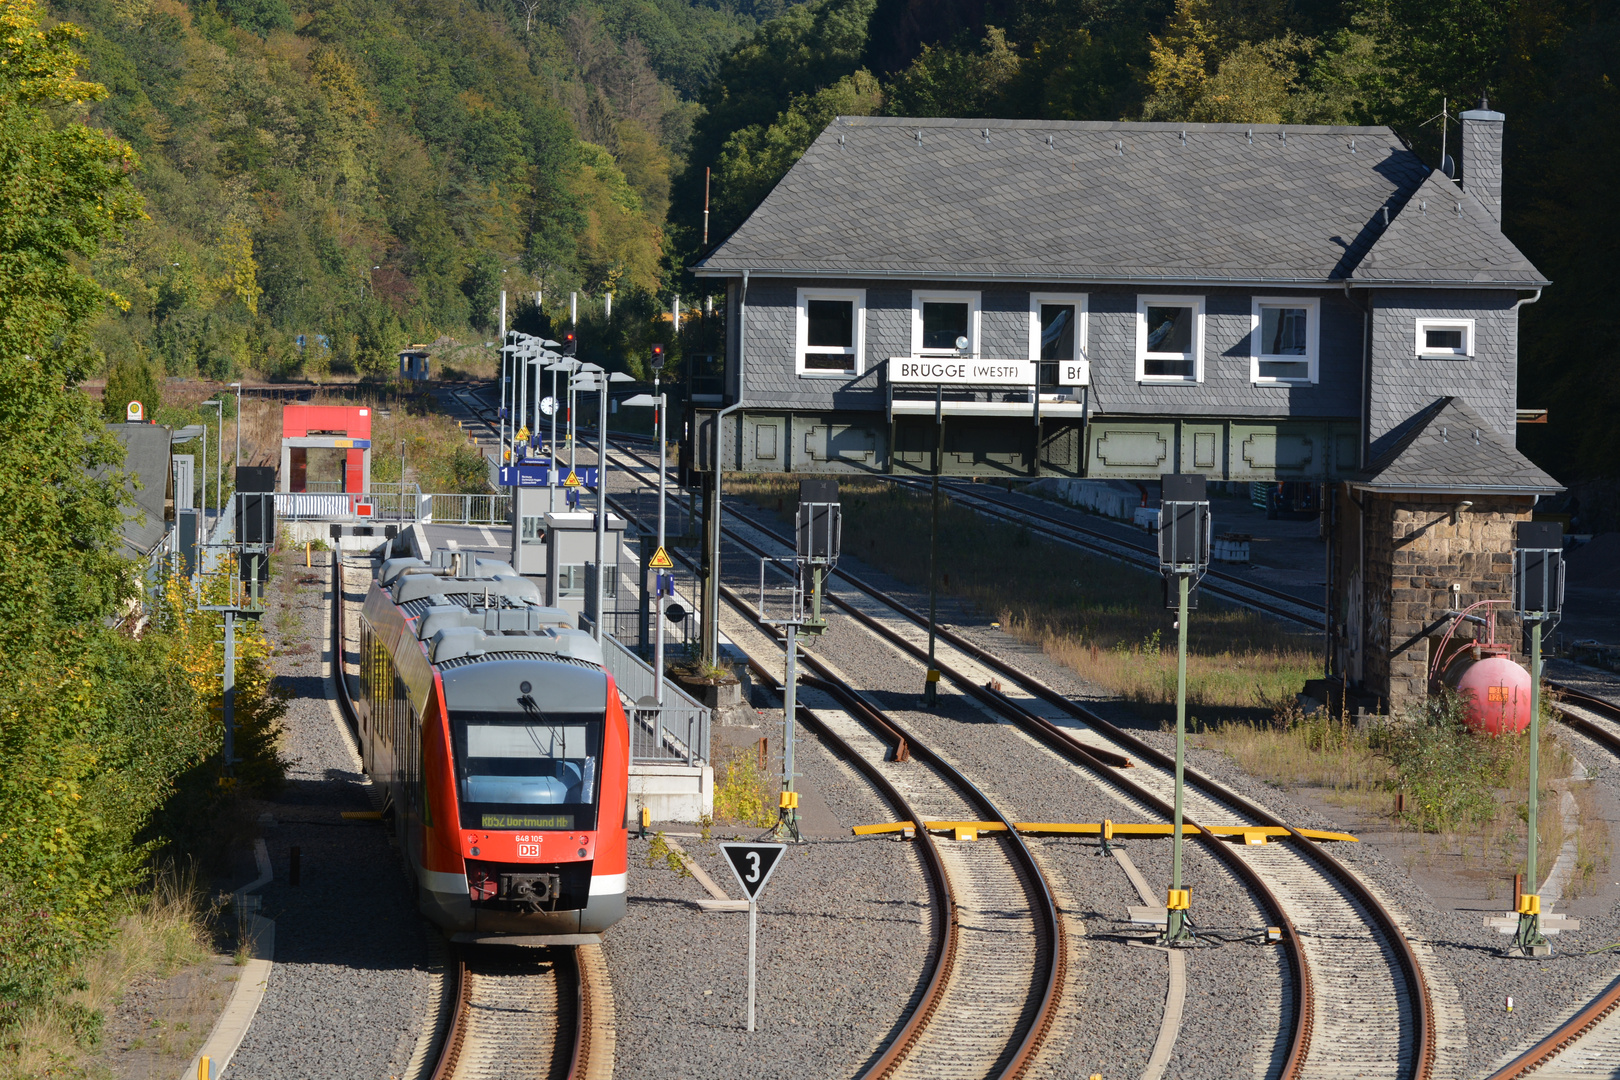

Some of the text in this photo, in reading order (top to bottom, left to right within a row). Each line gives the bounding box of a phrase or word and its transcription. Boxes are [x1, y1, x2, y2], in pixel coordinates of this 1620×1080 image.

[901, 363, 1019, 378] BRÜGGE (WESTF)
[1067, 366, 1082, 380] Bf
[501, 467, 508, 481] 1
[482, 816, 505, 827] RB52
[507, 816, 554, 827] Dortmund
[520, 845, 538, 855] DB
[745, 851, 760, 882] 3
